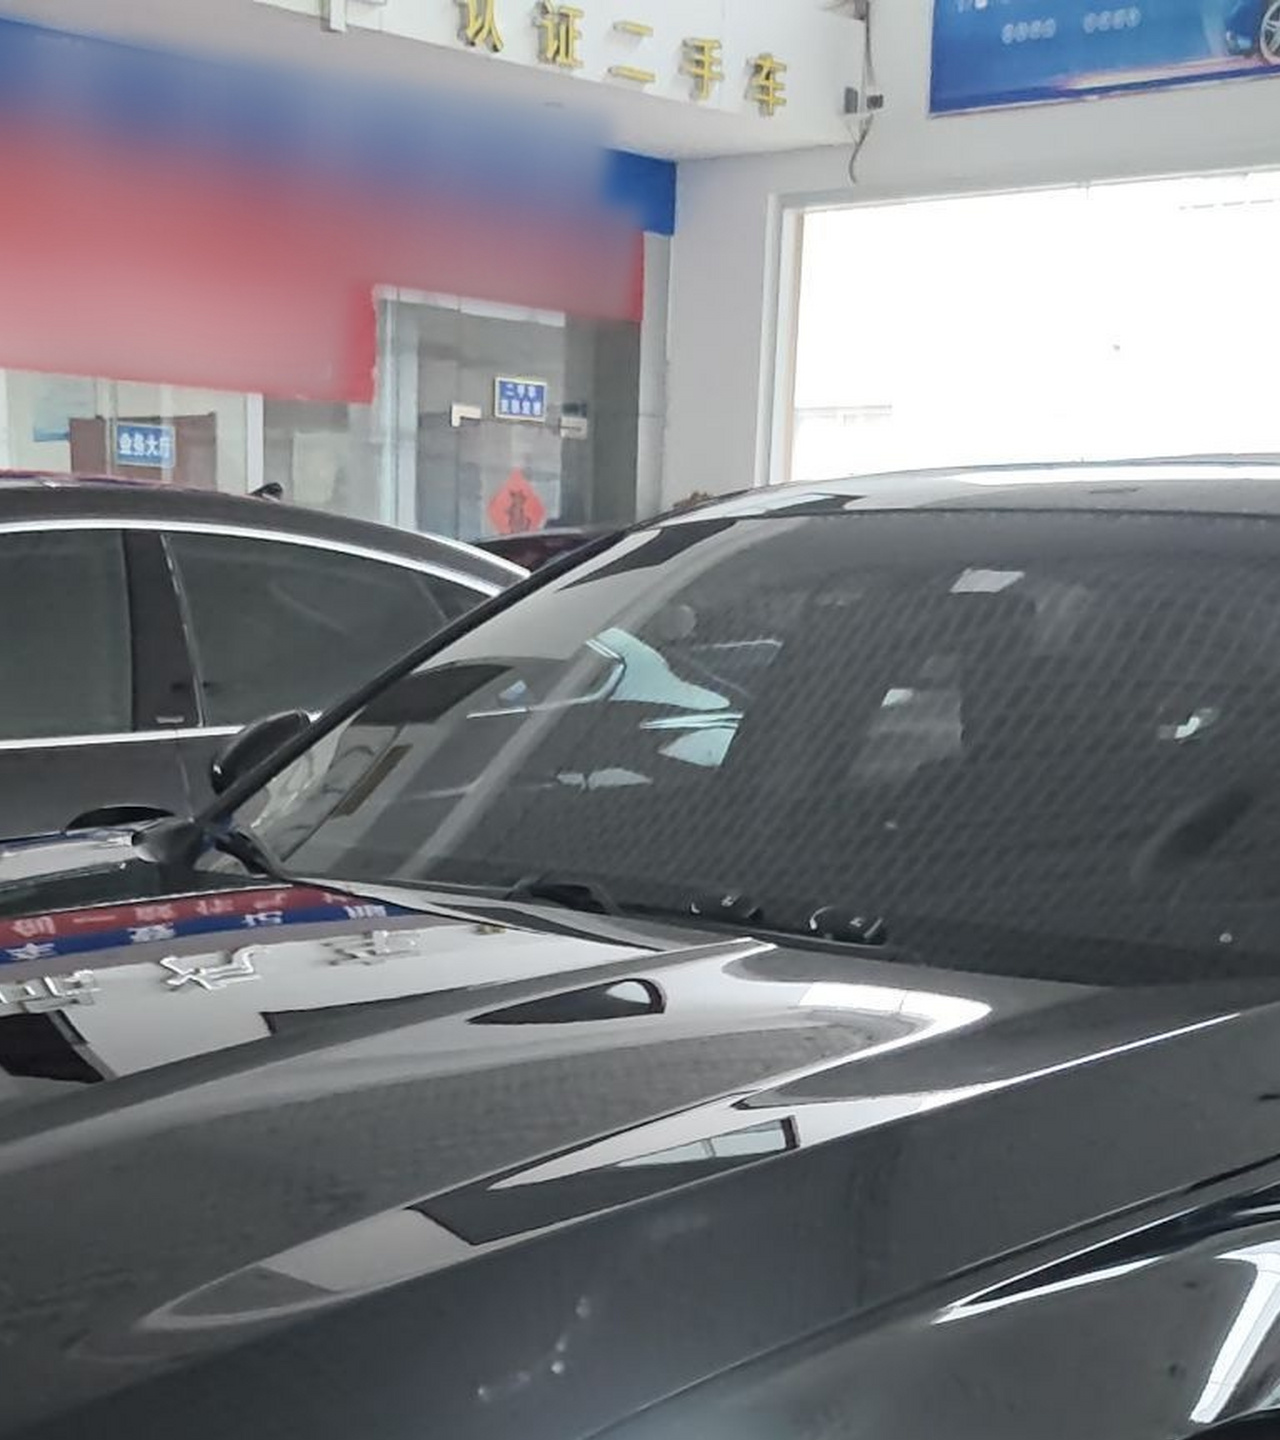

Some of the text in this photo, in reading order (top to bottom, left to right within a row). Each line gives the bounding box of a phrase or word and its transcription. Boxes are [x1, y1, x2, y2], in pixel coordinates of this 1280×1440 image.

[458, 0, 787, 117] 认证二手车
